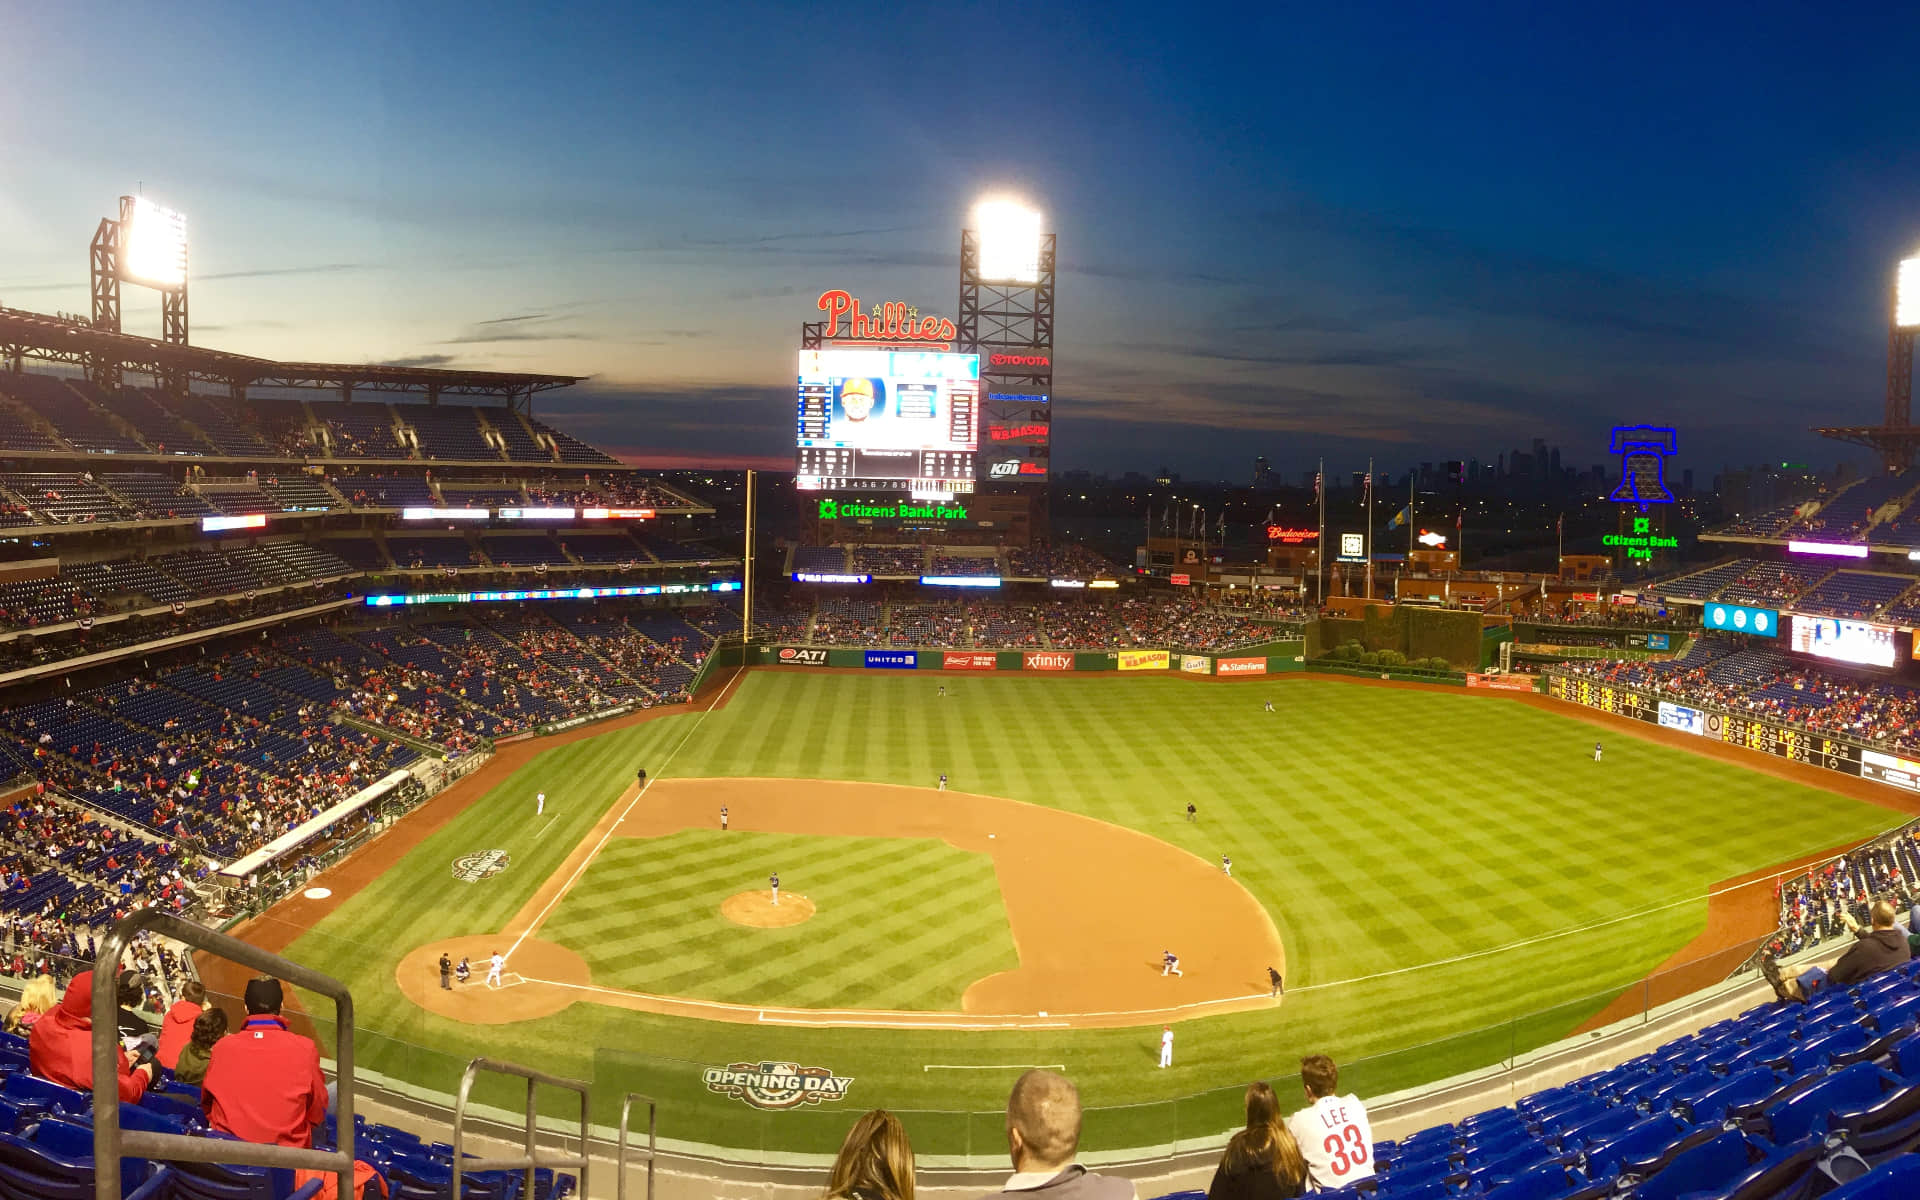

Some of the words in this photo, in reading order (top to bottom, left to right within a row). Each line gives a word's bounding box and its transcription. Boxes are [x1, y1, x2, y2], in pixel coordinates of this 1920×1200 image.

[818, 290, 956, 340] Phillies
[1004, 355, 1049, 366] TOYOTA
[841, 505, 895, 517] Citizens
[900, 505, 935, 518] Bank
[936, 506, 967, 519] Park
[1268, 526, 1319, 538] Budweiser
[1603, 535, 1648, 546] Citizens
[1650, 536, 1678, 547] Bank
[1628, 547, 1652, 558] Park
[795, 650, 827, 660] ATI
[1027, 653, 1071, 669] xfinity
[705, 1070, 801, 1090] OPENING
[804, 1077, 853, 1092] DAY
[1320, 1106, 1349, 1129] LEE
[1323, 1124, 1368, 1176] 33
